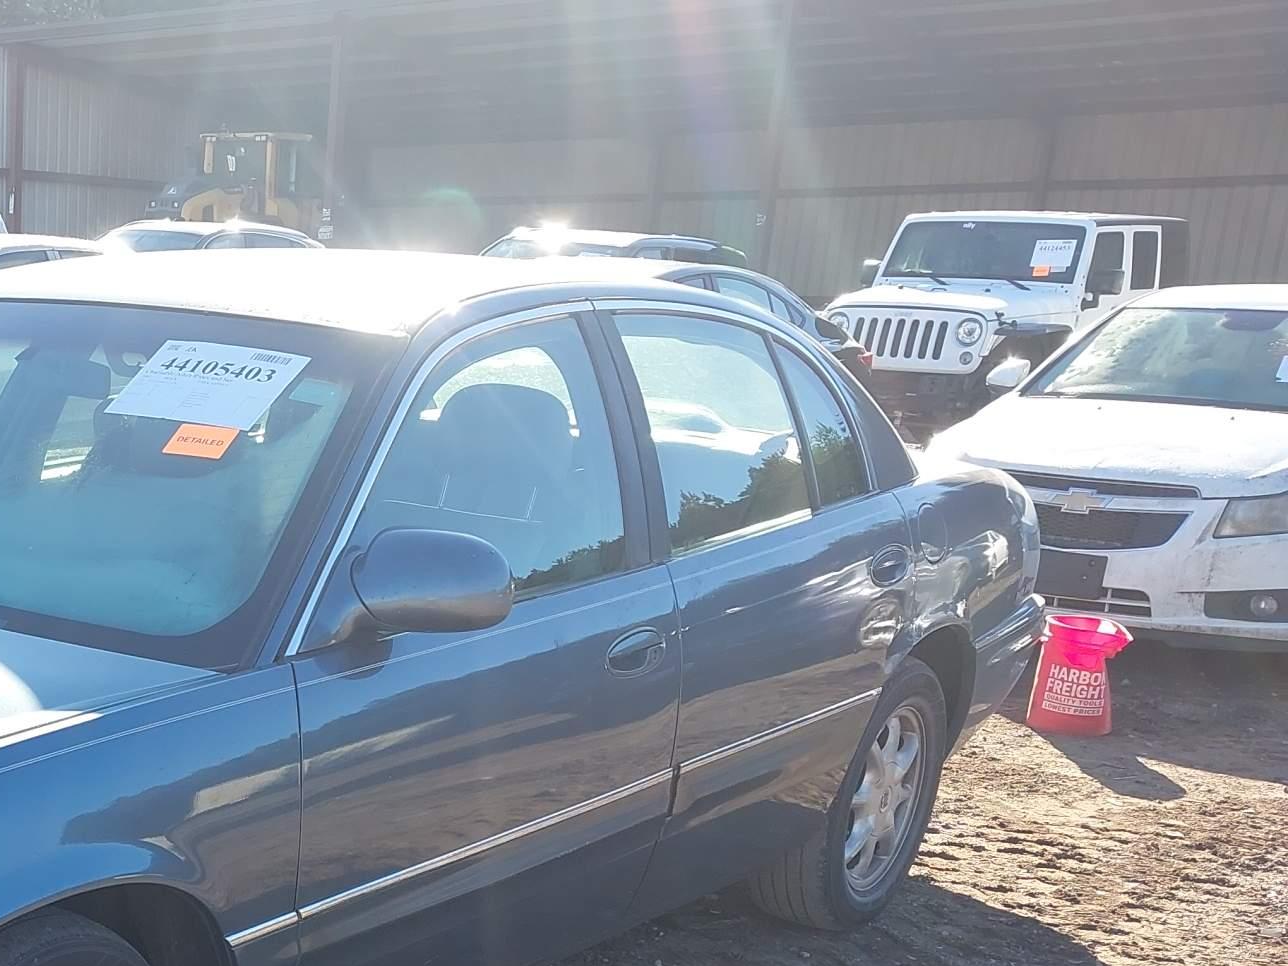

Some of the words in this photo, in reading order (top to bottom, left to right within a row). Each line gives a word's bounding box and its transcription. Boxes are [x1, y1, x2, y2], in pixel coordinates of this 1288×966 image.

[160, 356, 277, 383] 44105403
[176, 435, 225, 447] DETAILED
[1046, 678, 1106, 699] FREIGHT
[1044, 701, 1072, 713] LOWEST
[1046, 694, 1076, 705] QUALITY
[1079, 699, 1103, 707] TOOLS
